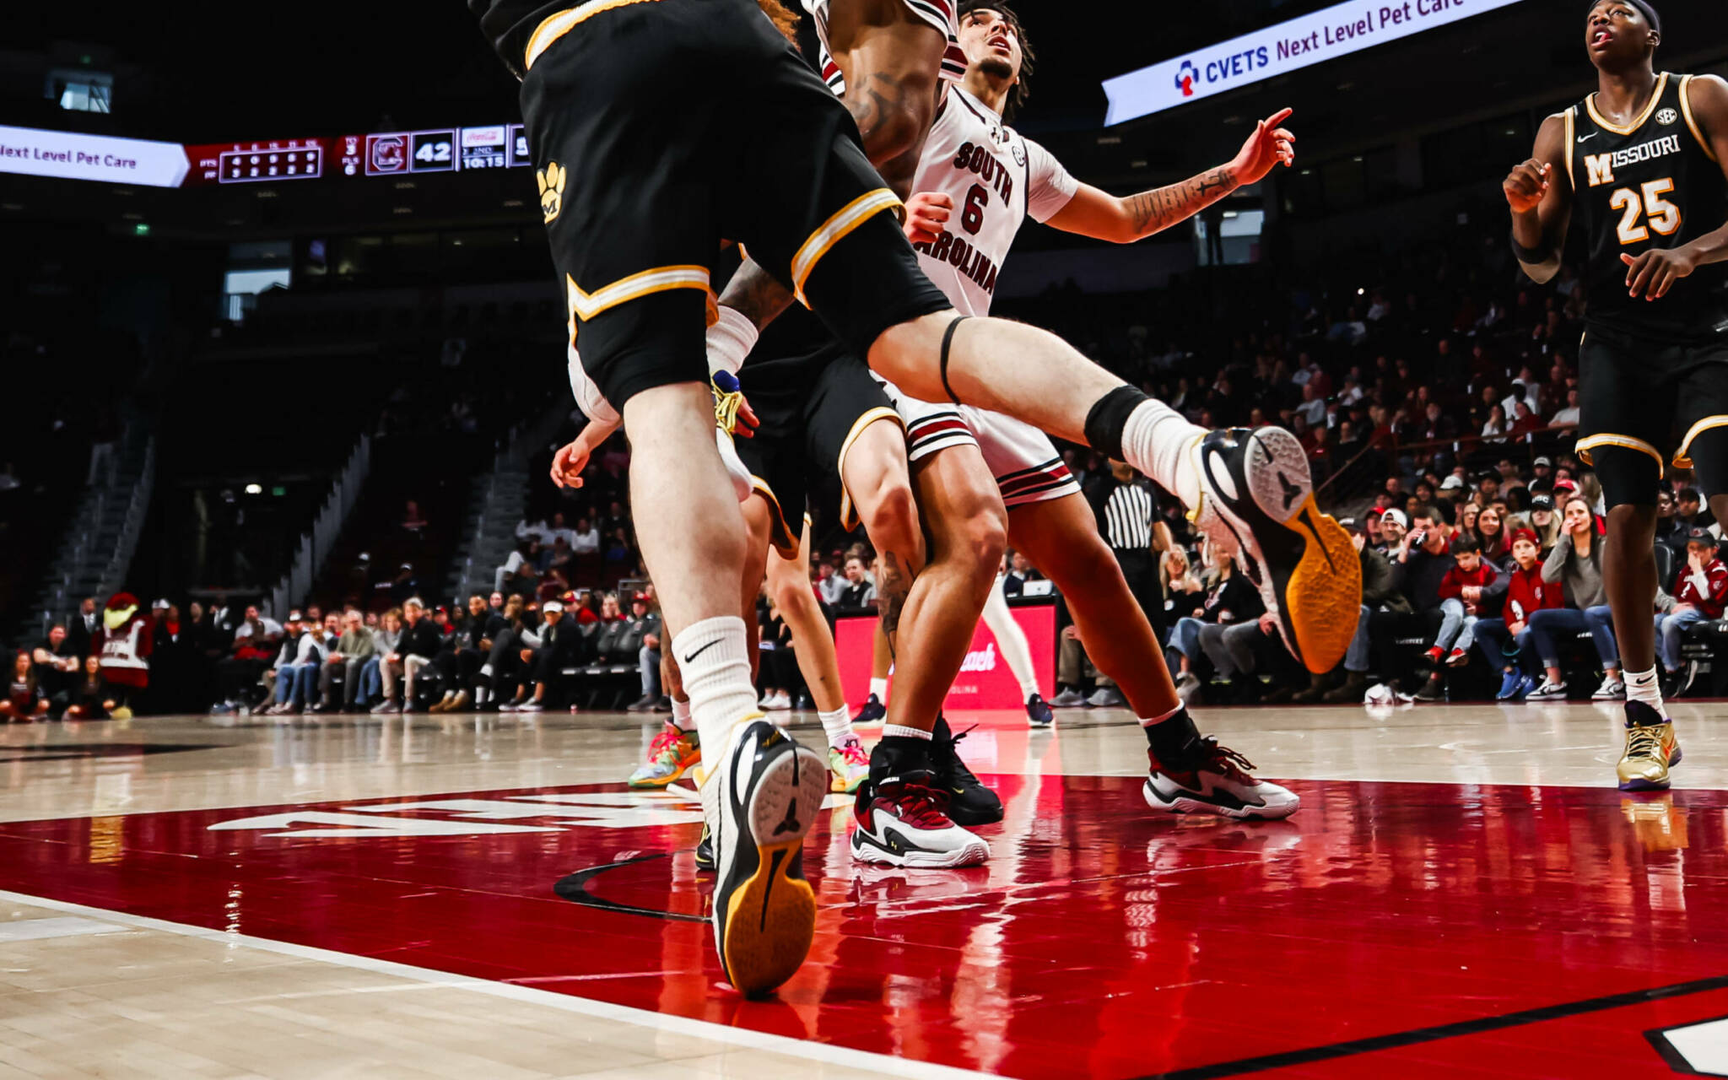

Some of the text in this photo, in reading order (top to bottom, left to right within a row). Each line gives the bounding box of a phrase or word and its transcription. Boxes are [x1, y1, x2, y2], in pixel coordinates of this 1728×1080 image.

[1206, 46, 1269, 83] CVETS
[1276, 31, 1319, 61] Next
[1324, 11, 1374, 46] Level
[1379, 1, 1412, 29] Pet
[1656, 110, 1677, 124] SEC
[34, 148, 71, 163] Level
[76, 152, 100, 165] Pet
[104, 155, 137, 169] Care
[415, 142, 451, 162] 42
[463, 156, 504, 169] 10:15
[953, 141, 1014, 209] SOUTH
[1584, 134, 1682, 188] MISSOURI
[961, 182, 989, 236] 6
[1609, 177, 1682, 245] 25
[912, 230, 998, 296] AROLINA
